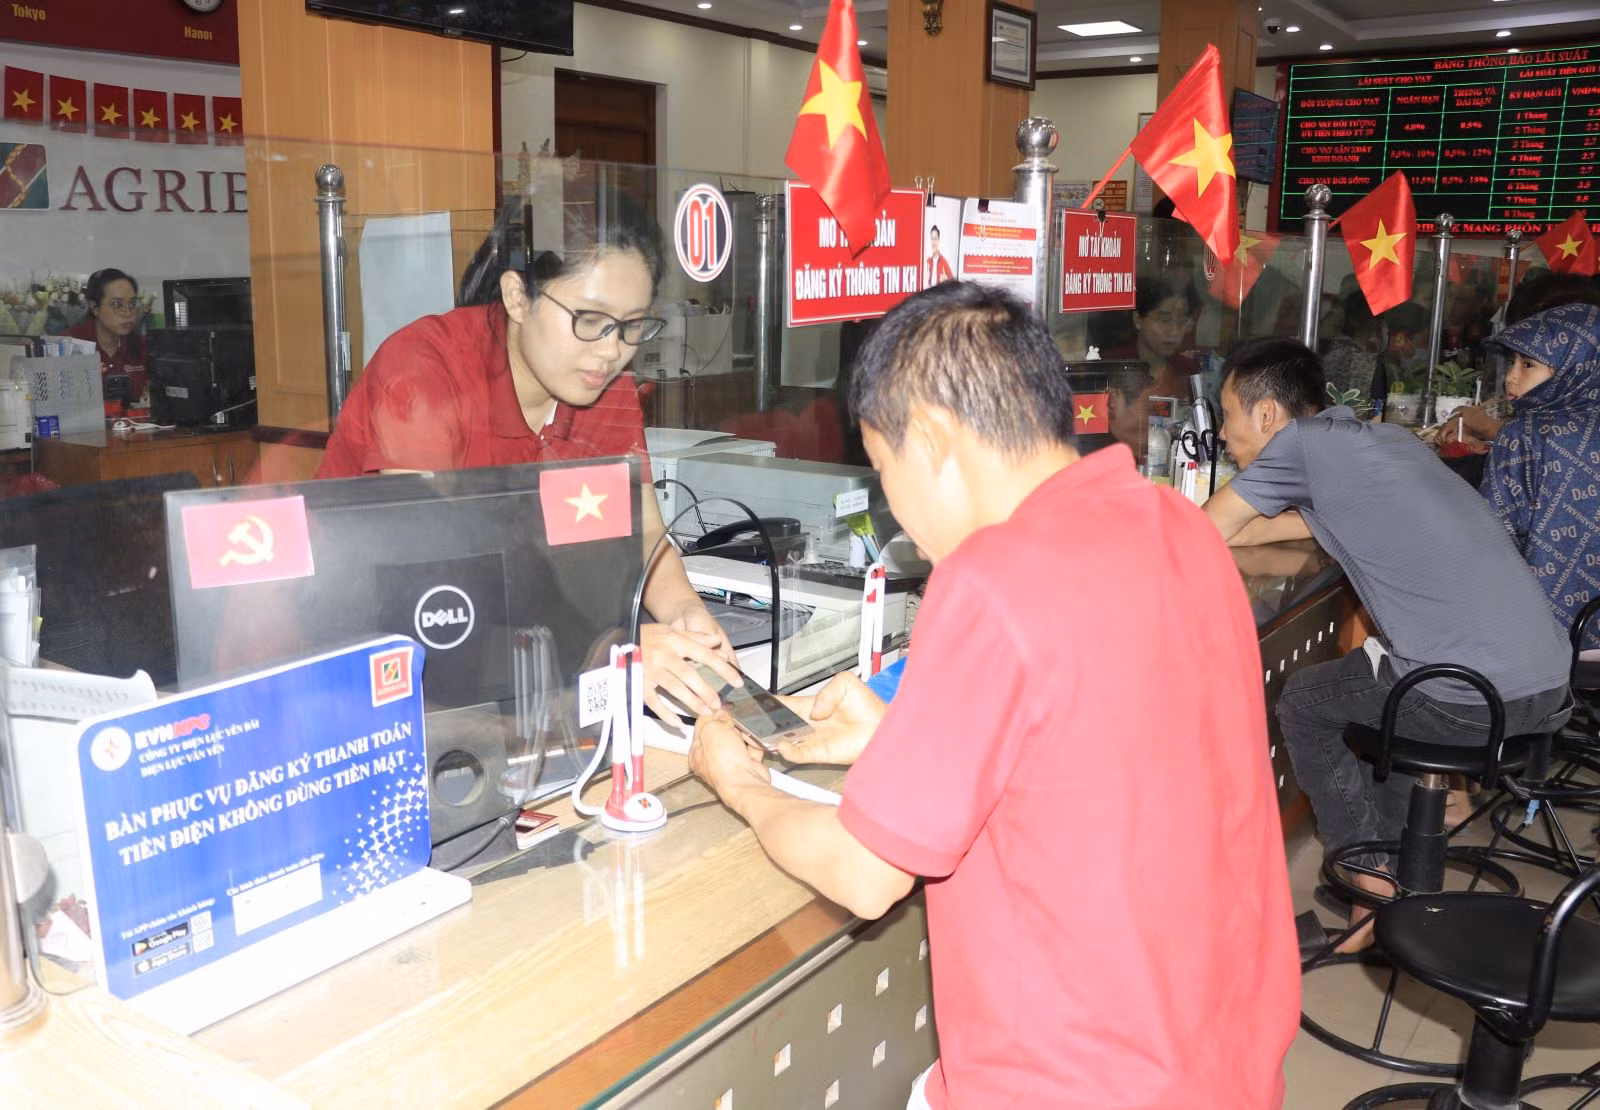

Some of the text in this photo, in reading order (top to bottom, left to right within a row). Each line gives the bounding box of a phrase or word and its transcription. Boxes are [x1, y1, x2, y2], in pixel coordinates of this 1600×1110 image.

[12, 4, 46, 20] Tokyo
[687, 199, 718, 272] 01
[795, 261, 918, 300] ĐĂNG KÝ THÔNG TIN KH
[1064, 268, 1133, 295] ĐĂNG KÝ THÔNG TIN KH
[1551, 421, 1578, 436] D&G
[1571, 484, 1597, 500] D&G
[1550, 525, 1576, 542] D&G
[422, 607, 468, 628] DELL
[104, 721, 412, 842] BÀN PHỤC VỤ ĐĂNG KÝ THANH TOÁN
[119, 750, 406, 866] TIỀN ĐIỆN KHÔNG DÙNG TIỀN MẶT
